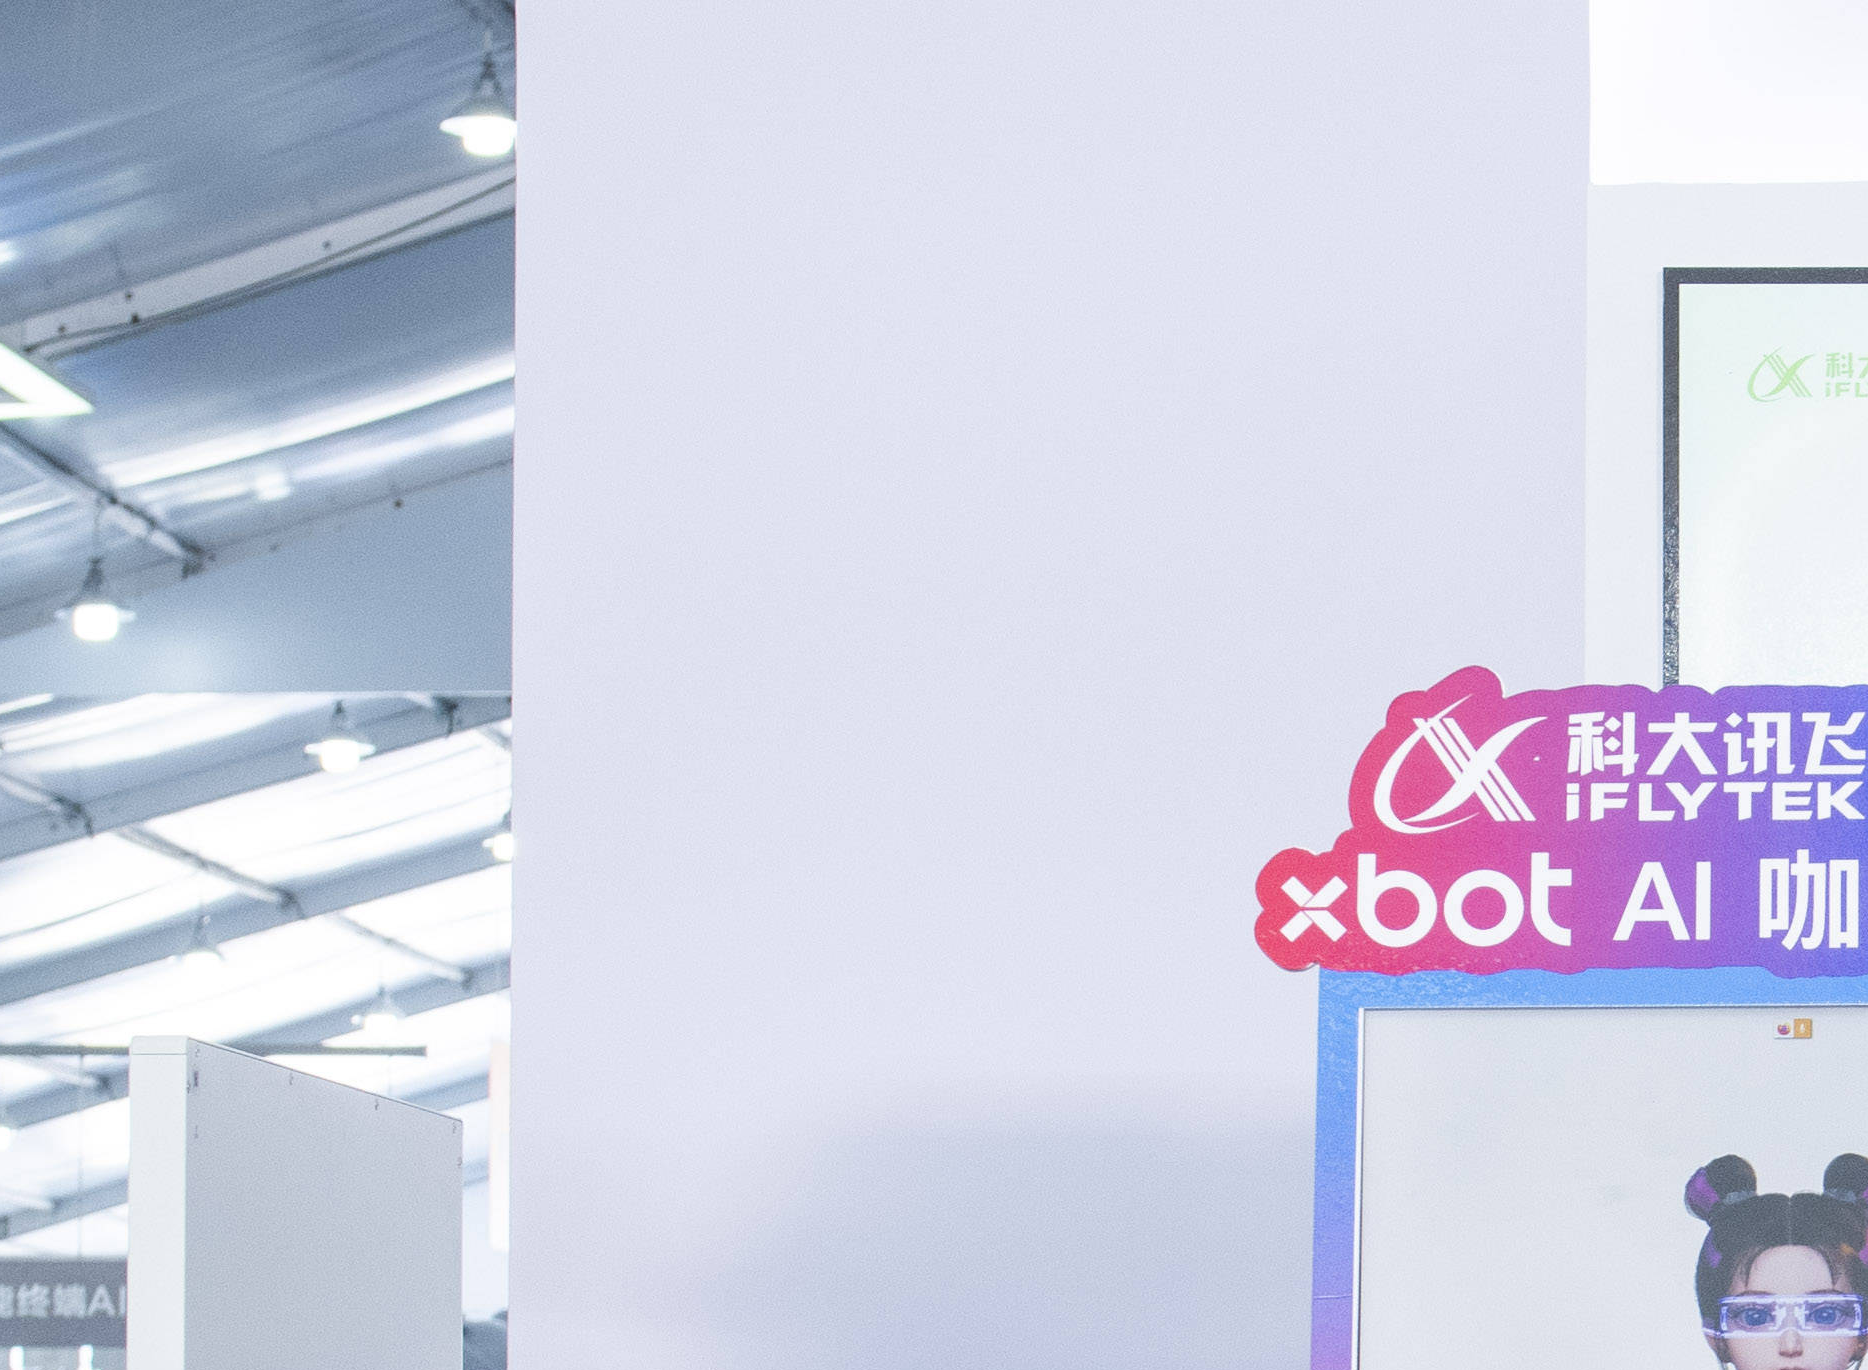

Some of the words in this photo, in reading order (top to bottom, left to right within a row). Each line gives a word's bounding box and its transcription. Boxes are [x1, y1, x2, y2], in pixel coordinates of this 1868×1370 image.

[1565, 710, 1867, 777] 科大讯飞
[1564, 781, 1867, 822] iFLYTEK
[1279, 851, 1573, 948] xbot
[1612, 860, 1712, 942] AI
